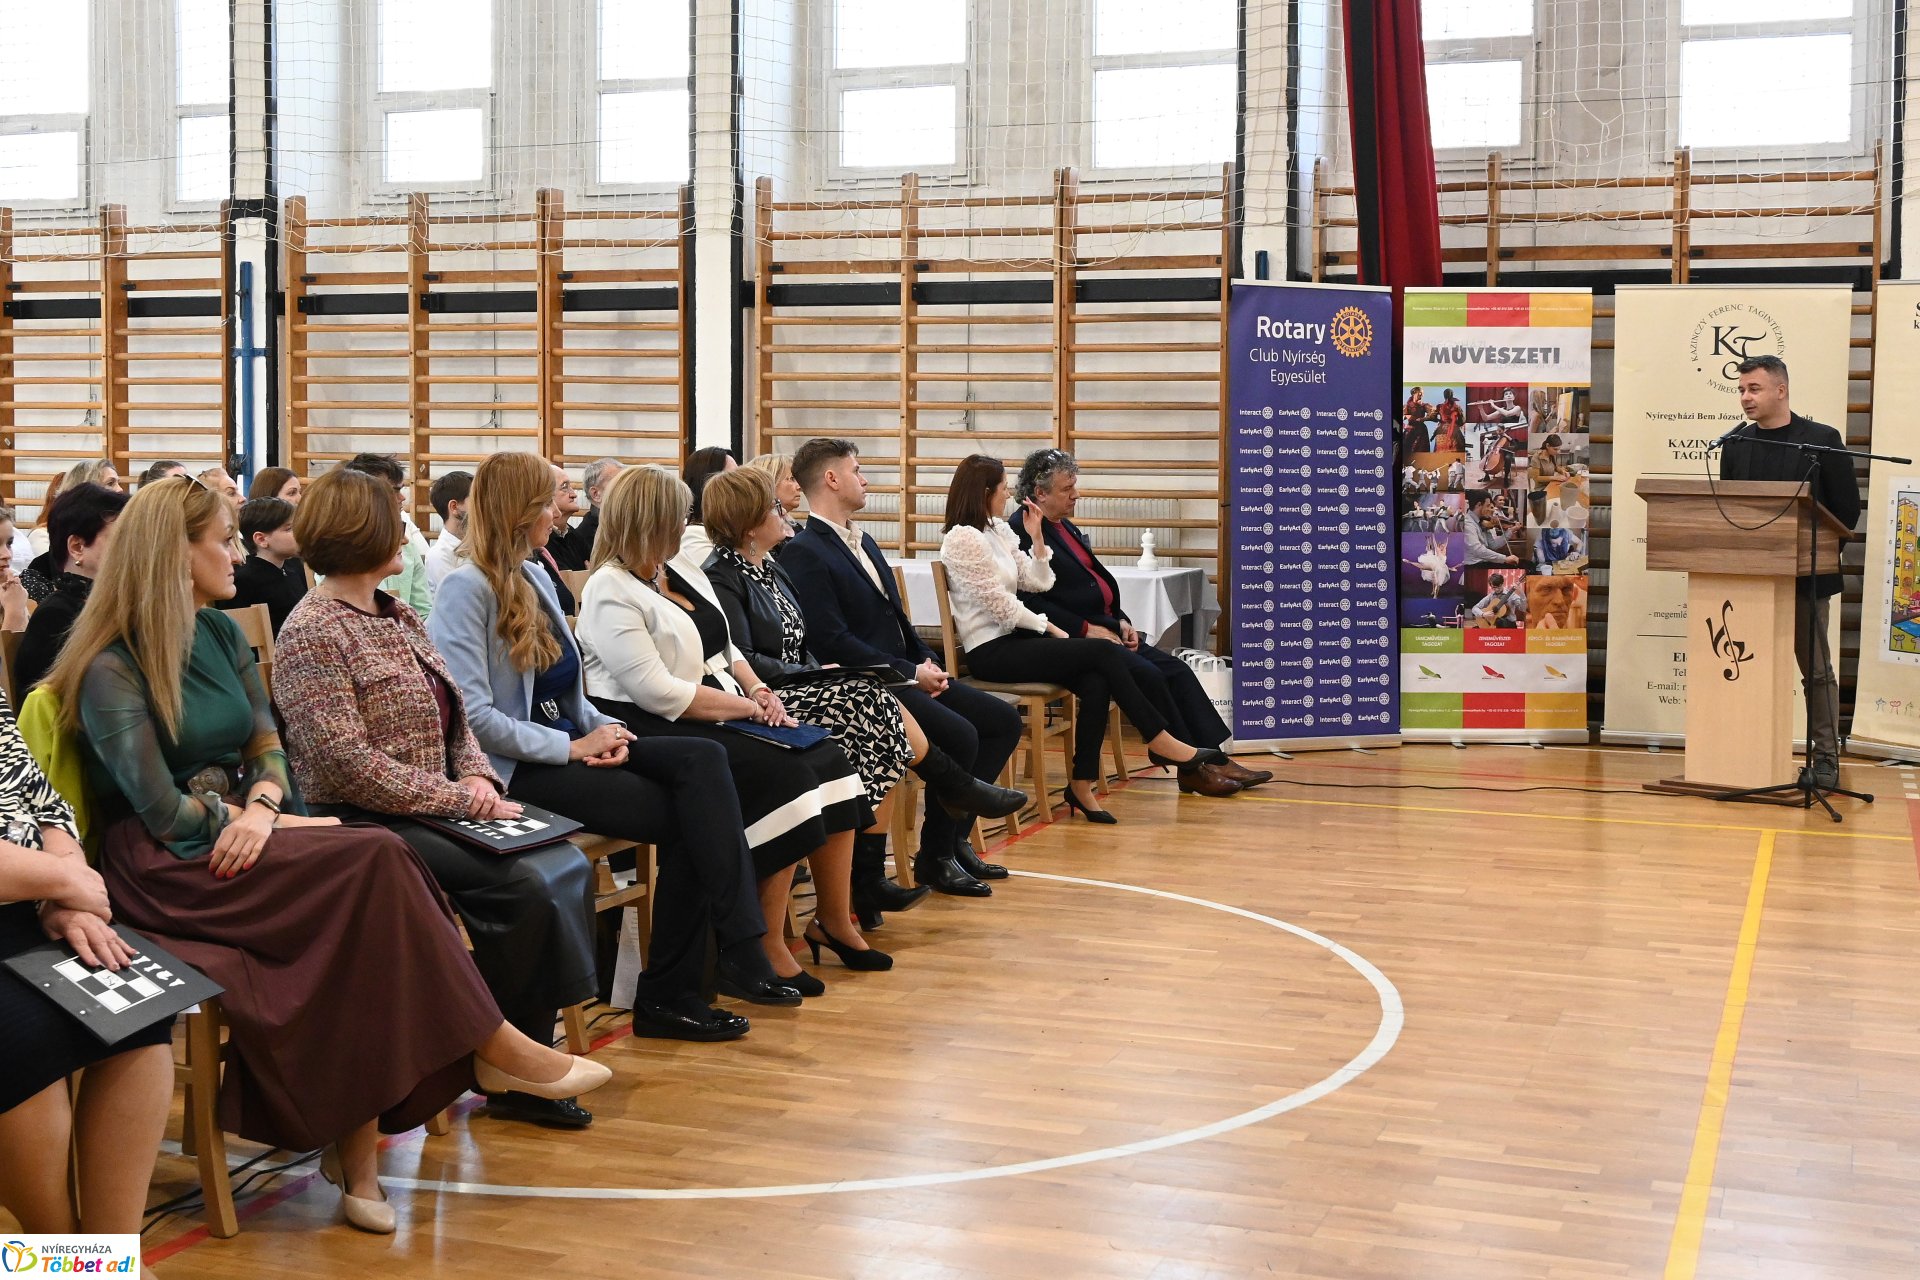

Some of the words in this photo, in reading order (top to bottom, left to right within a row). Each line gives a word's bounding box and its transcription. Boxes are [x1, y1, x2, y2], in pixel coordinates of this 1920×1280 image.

[1257, 316, 1326, 344] Rotary
[1690, 318, 1708, 362] KAZINCZY
[1708, 304, 1744, 319] FERENC
[1748, 305, 1785, 358] TAGINTÉZMÉN
[1250, 348, 1278, 362] Club
[1282, 350, 1326, 366] Nyírség
[1428, 344, 1560, 364] MŰVÉSZETI
[1270, 369, 1326, 386] Egyesület
[1706, 378, 1738, 394] NYÍREG
[1646, 412, 1694, 421] Nyíregyházi
[1673, 451, 1720, 460] TAGINT
[1653, 610, 1687, 620] megemlé
[1673, 668, 1687, 676] Tel
[1648, 682, 1680, 690] E-mail:
[1659, 696, 1680, 704] Web:
